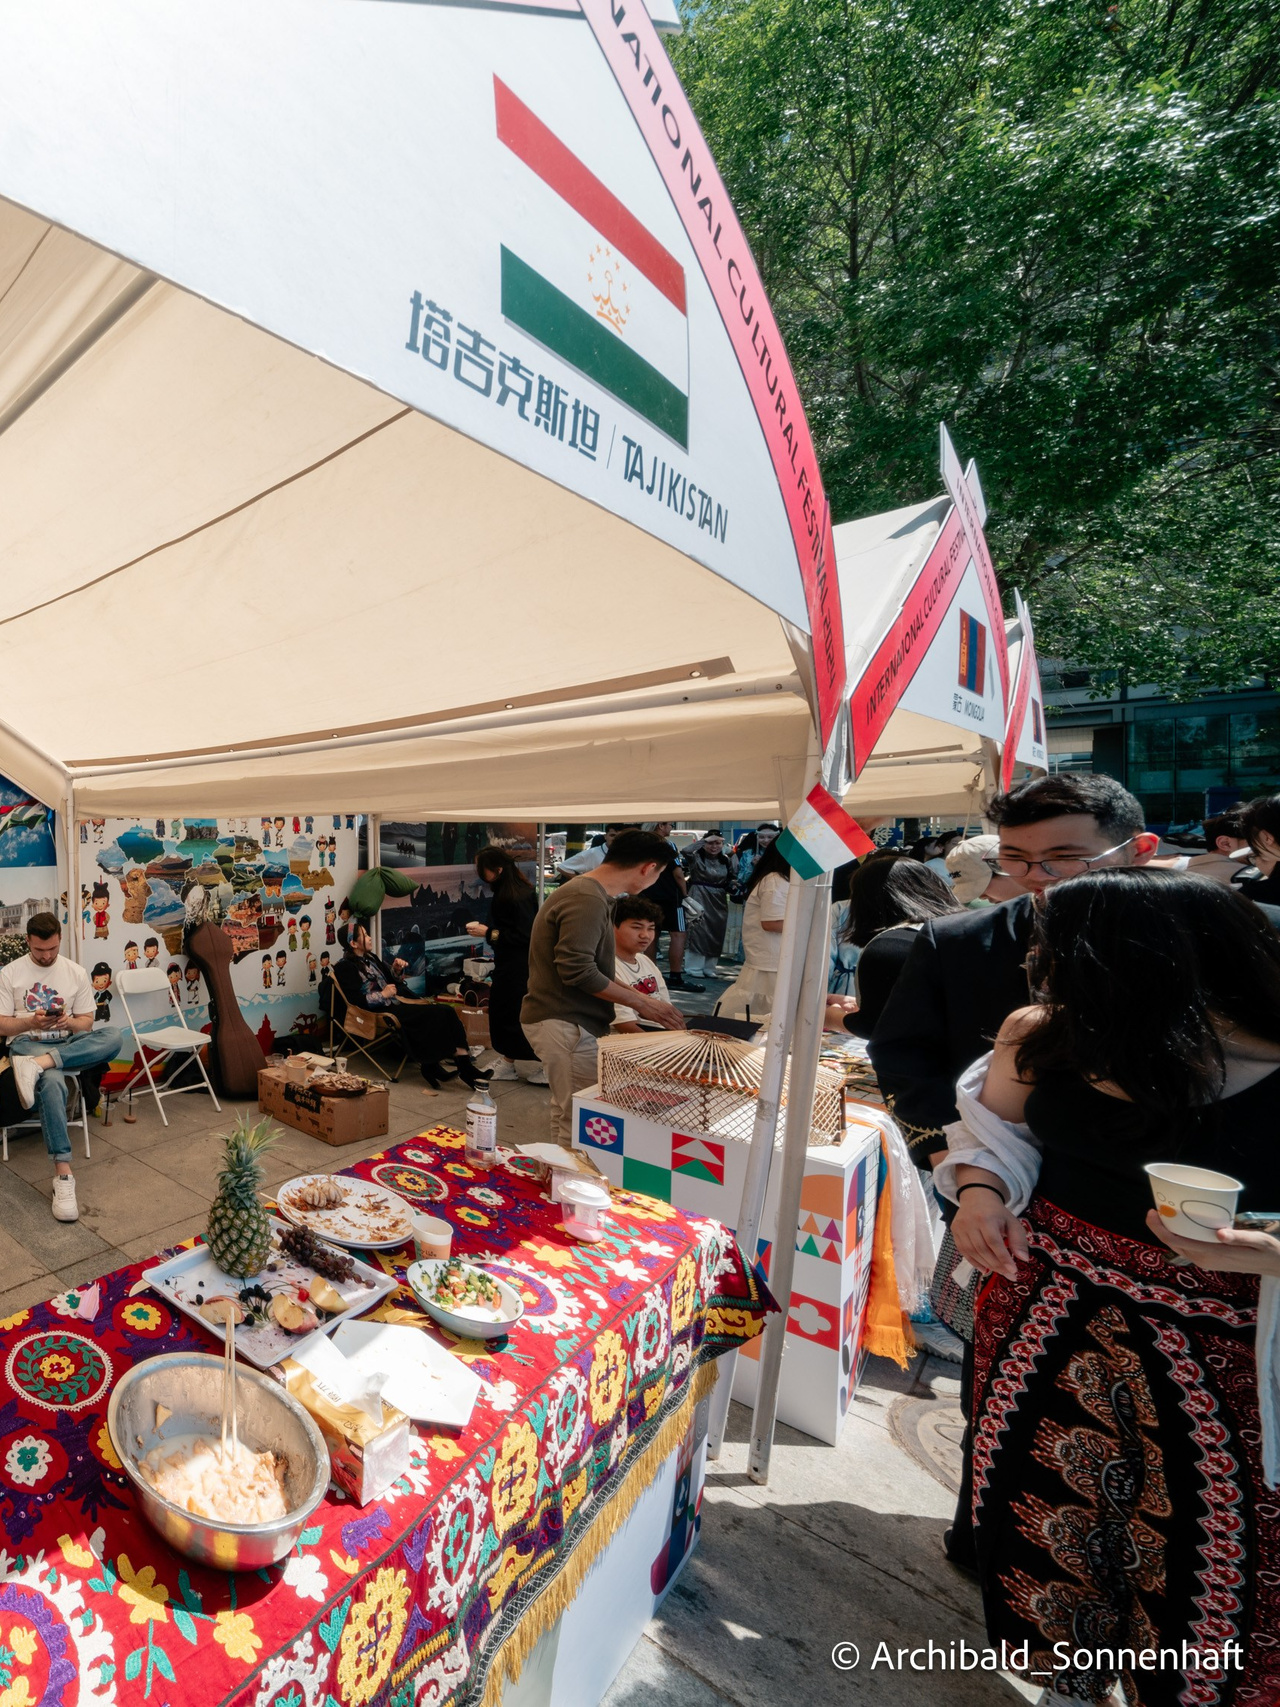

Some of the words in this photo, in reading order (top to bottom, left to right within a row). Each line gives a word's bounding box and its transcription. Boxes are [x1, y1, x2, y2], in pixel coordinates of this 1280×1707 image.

[405, 289, 600, 462] 塔吉克斯坦
[621, 434, 729, 544] TAJIKISTAN
[727, 258, 799, 475] CULTURAL
[797, 466, 830, 617] FESTIVAL
[822, 607, 838, 690] 2024
[865, 611, 925, 726] INTERNATIONAL
[922, 561, 952, 625] CULTURAL
[949, 526, 966, 577] FESTIV
